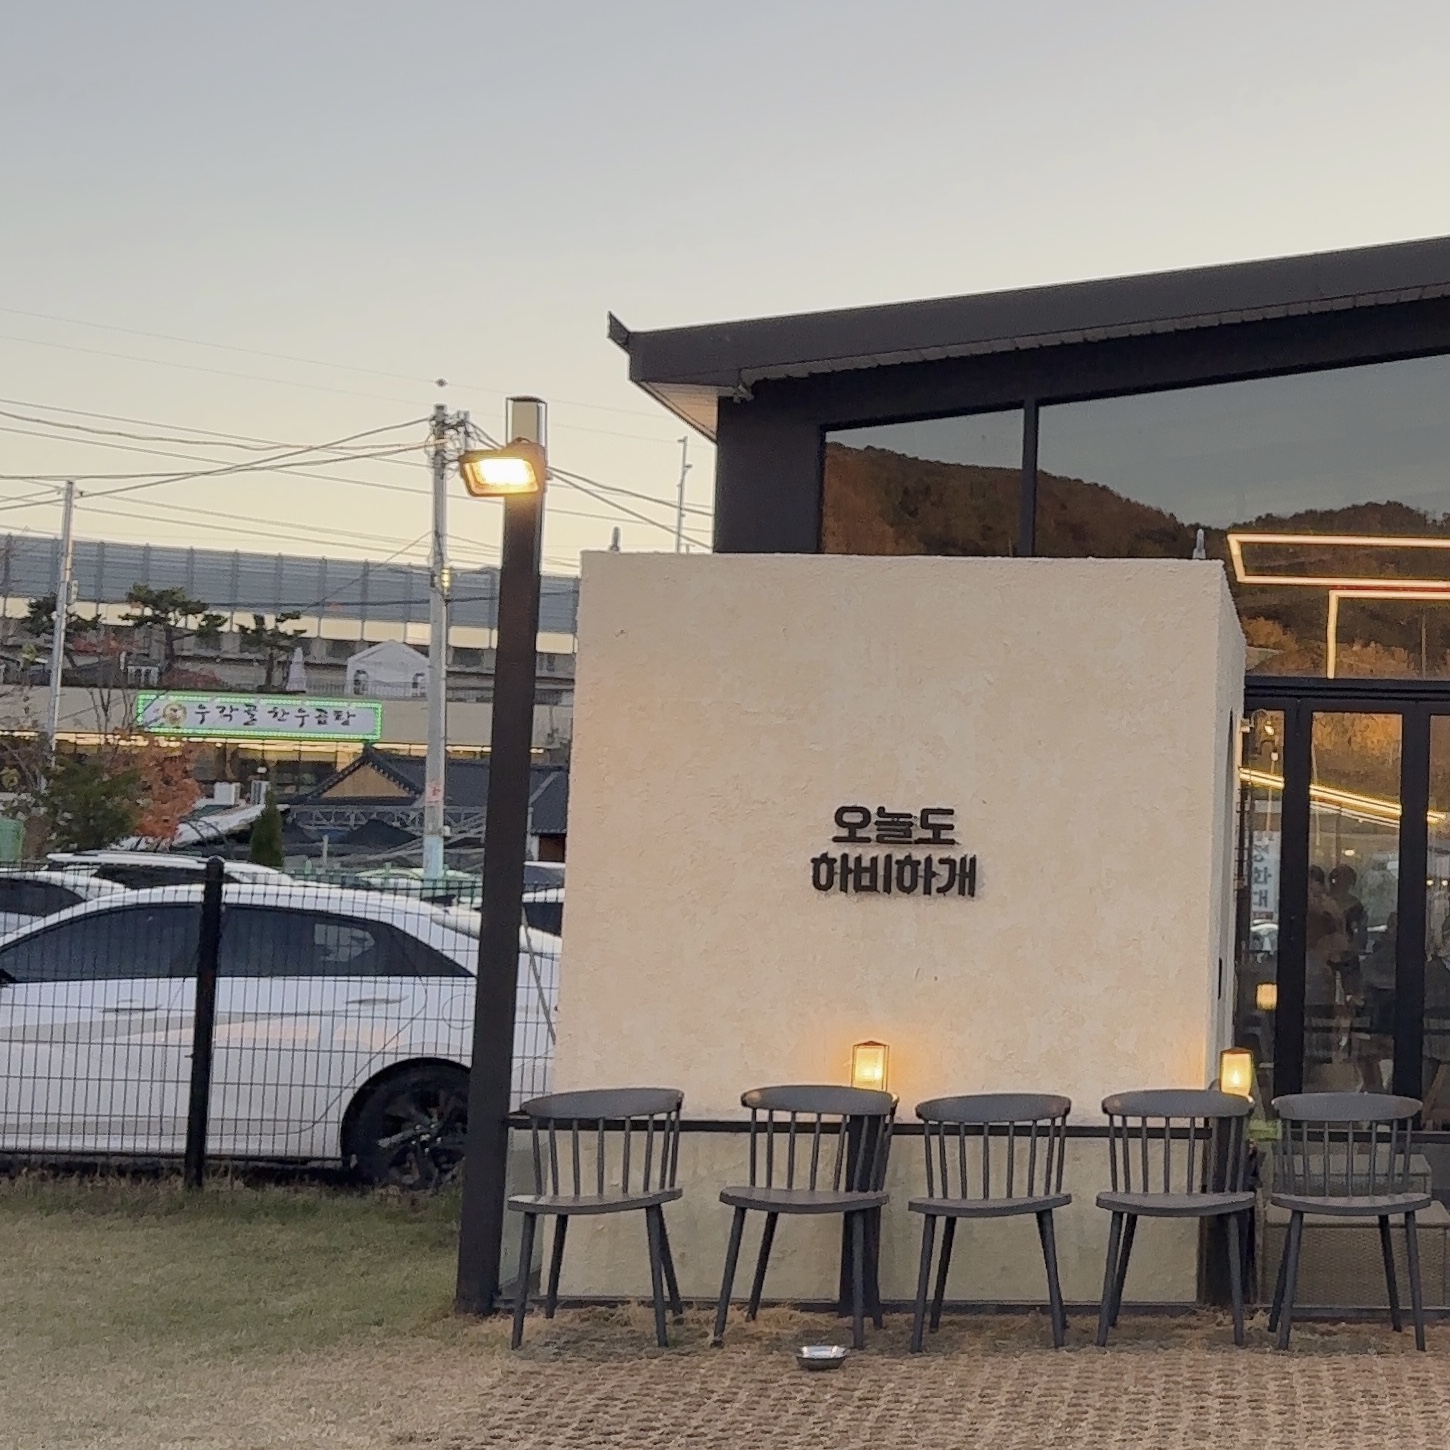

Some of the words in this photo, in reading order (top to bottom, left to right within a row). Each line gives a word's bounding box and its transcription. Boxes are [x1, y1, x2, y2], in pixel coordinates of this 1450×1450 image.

[194, 702, 259, 726] 우각골
[267, 705, 357, 728] 한우곰탕
[831, 805, 957, 845] 오늘도
[810, 852, 977, 897] 하비하개
